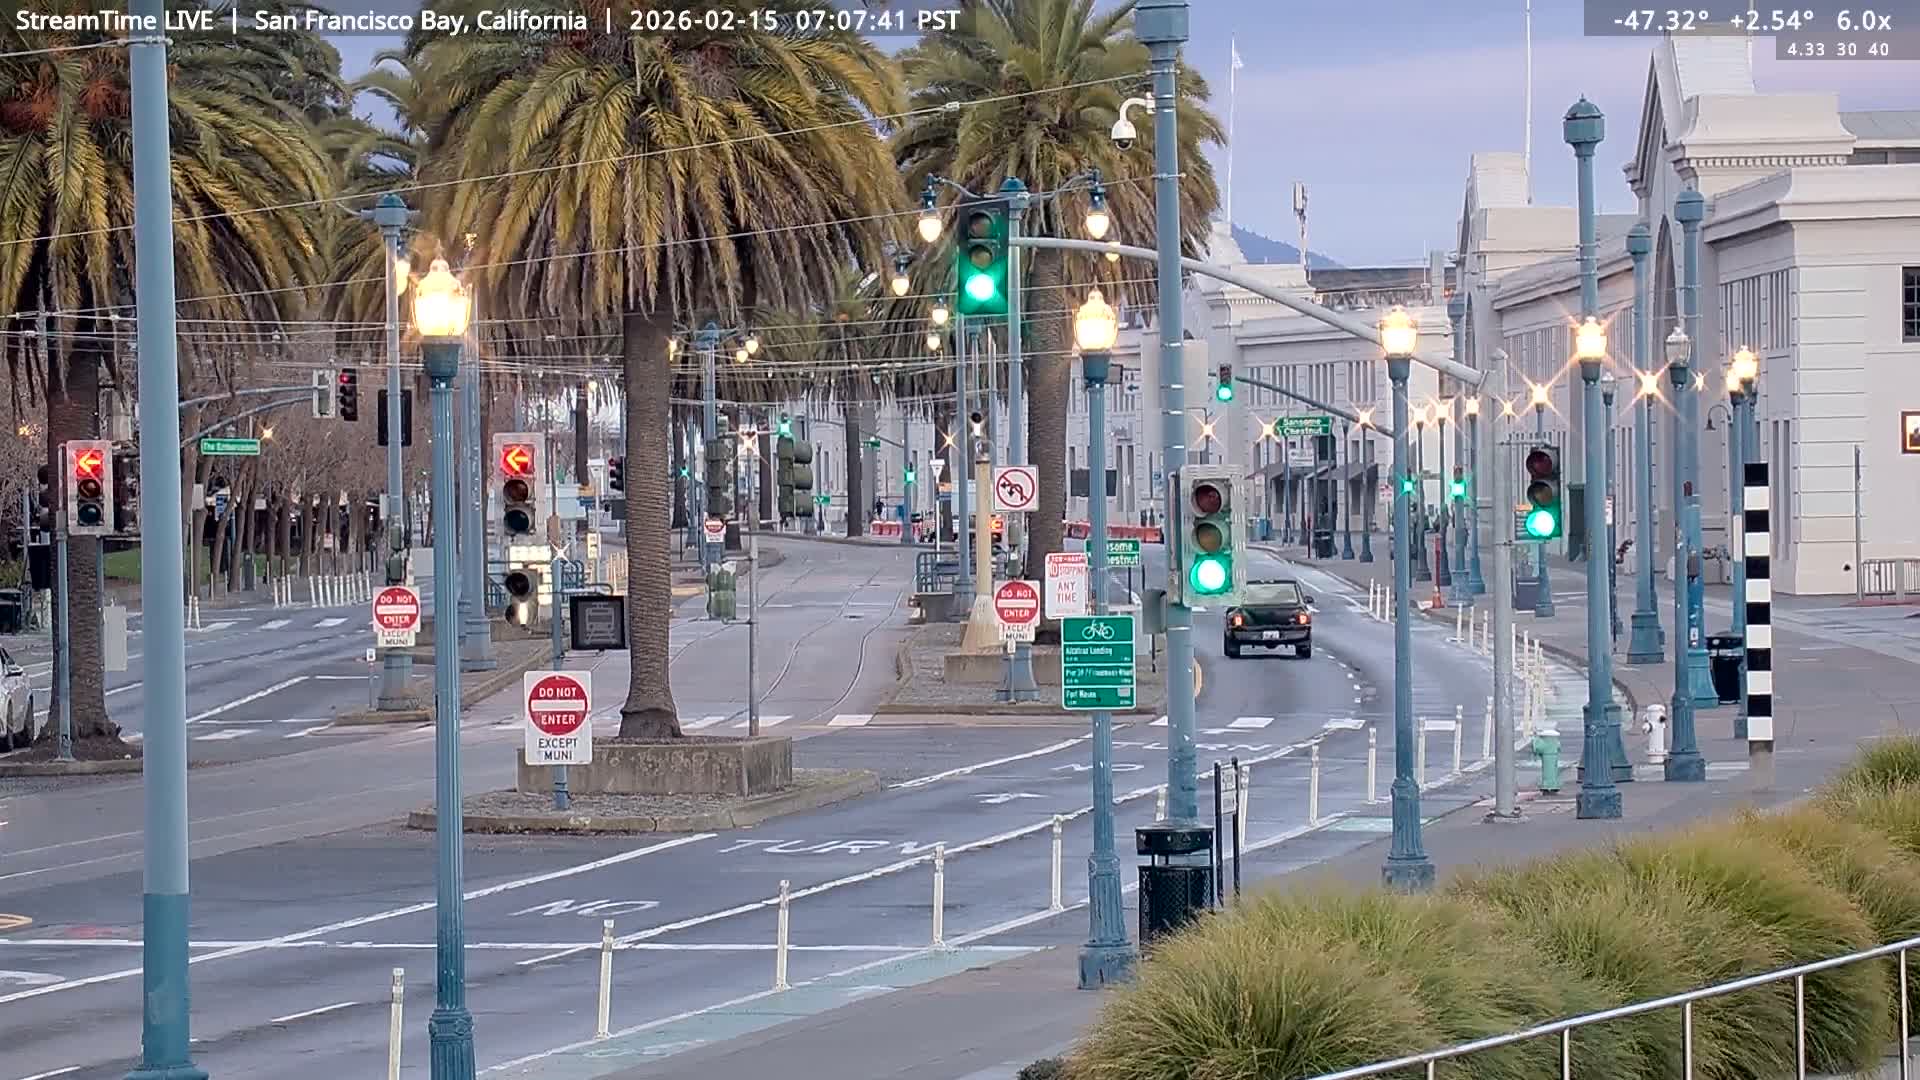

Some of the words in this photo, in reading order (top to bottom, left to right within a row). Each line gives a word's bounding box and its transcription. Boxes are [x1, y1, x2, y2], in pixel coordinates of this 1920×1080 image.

[1058, 581, 1076, 592] ANY
[1001, 590, 1013, 598] DO
[1016, 590, 1032, 598] NOT
[1057, 592, 1077, 603] TIME
[381, 595, 393, 604] DO
[396, 595, 413, 604] NOT
[1004, 609, 1030, 617] ENTER
[383, 615, 410, 624] ENTER
[539, 687, 554, 697] DO
[556, 687, 577, 697] NOT
[541, 714, 576, 725] ENTER
[538, 738, 577, 748] EXCEPT
[544, 750, 573, 760] MUNI
[718, 839, 950, 854] TURN
[506, 899, 661, 917] NO
